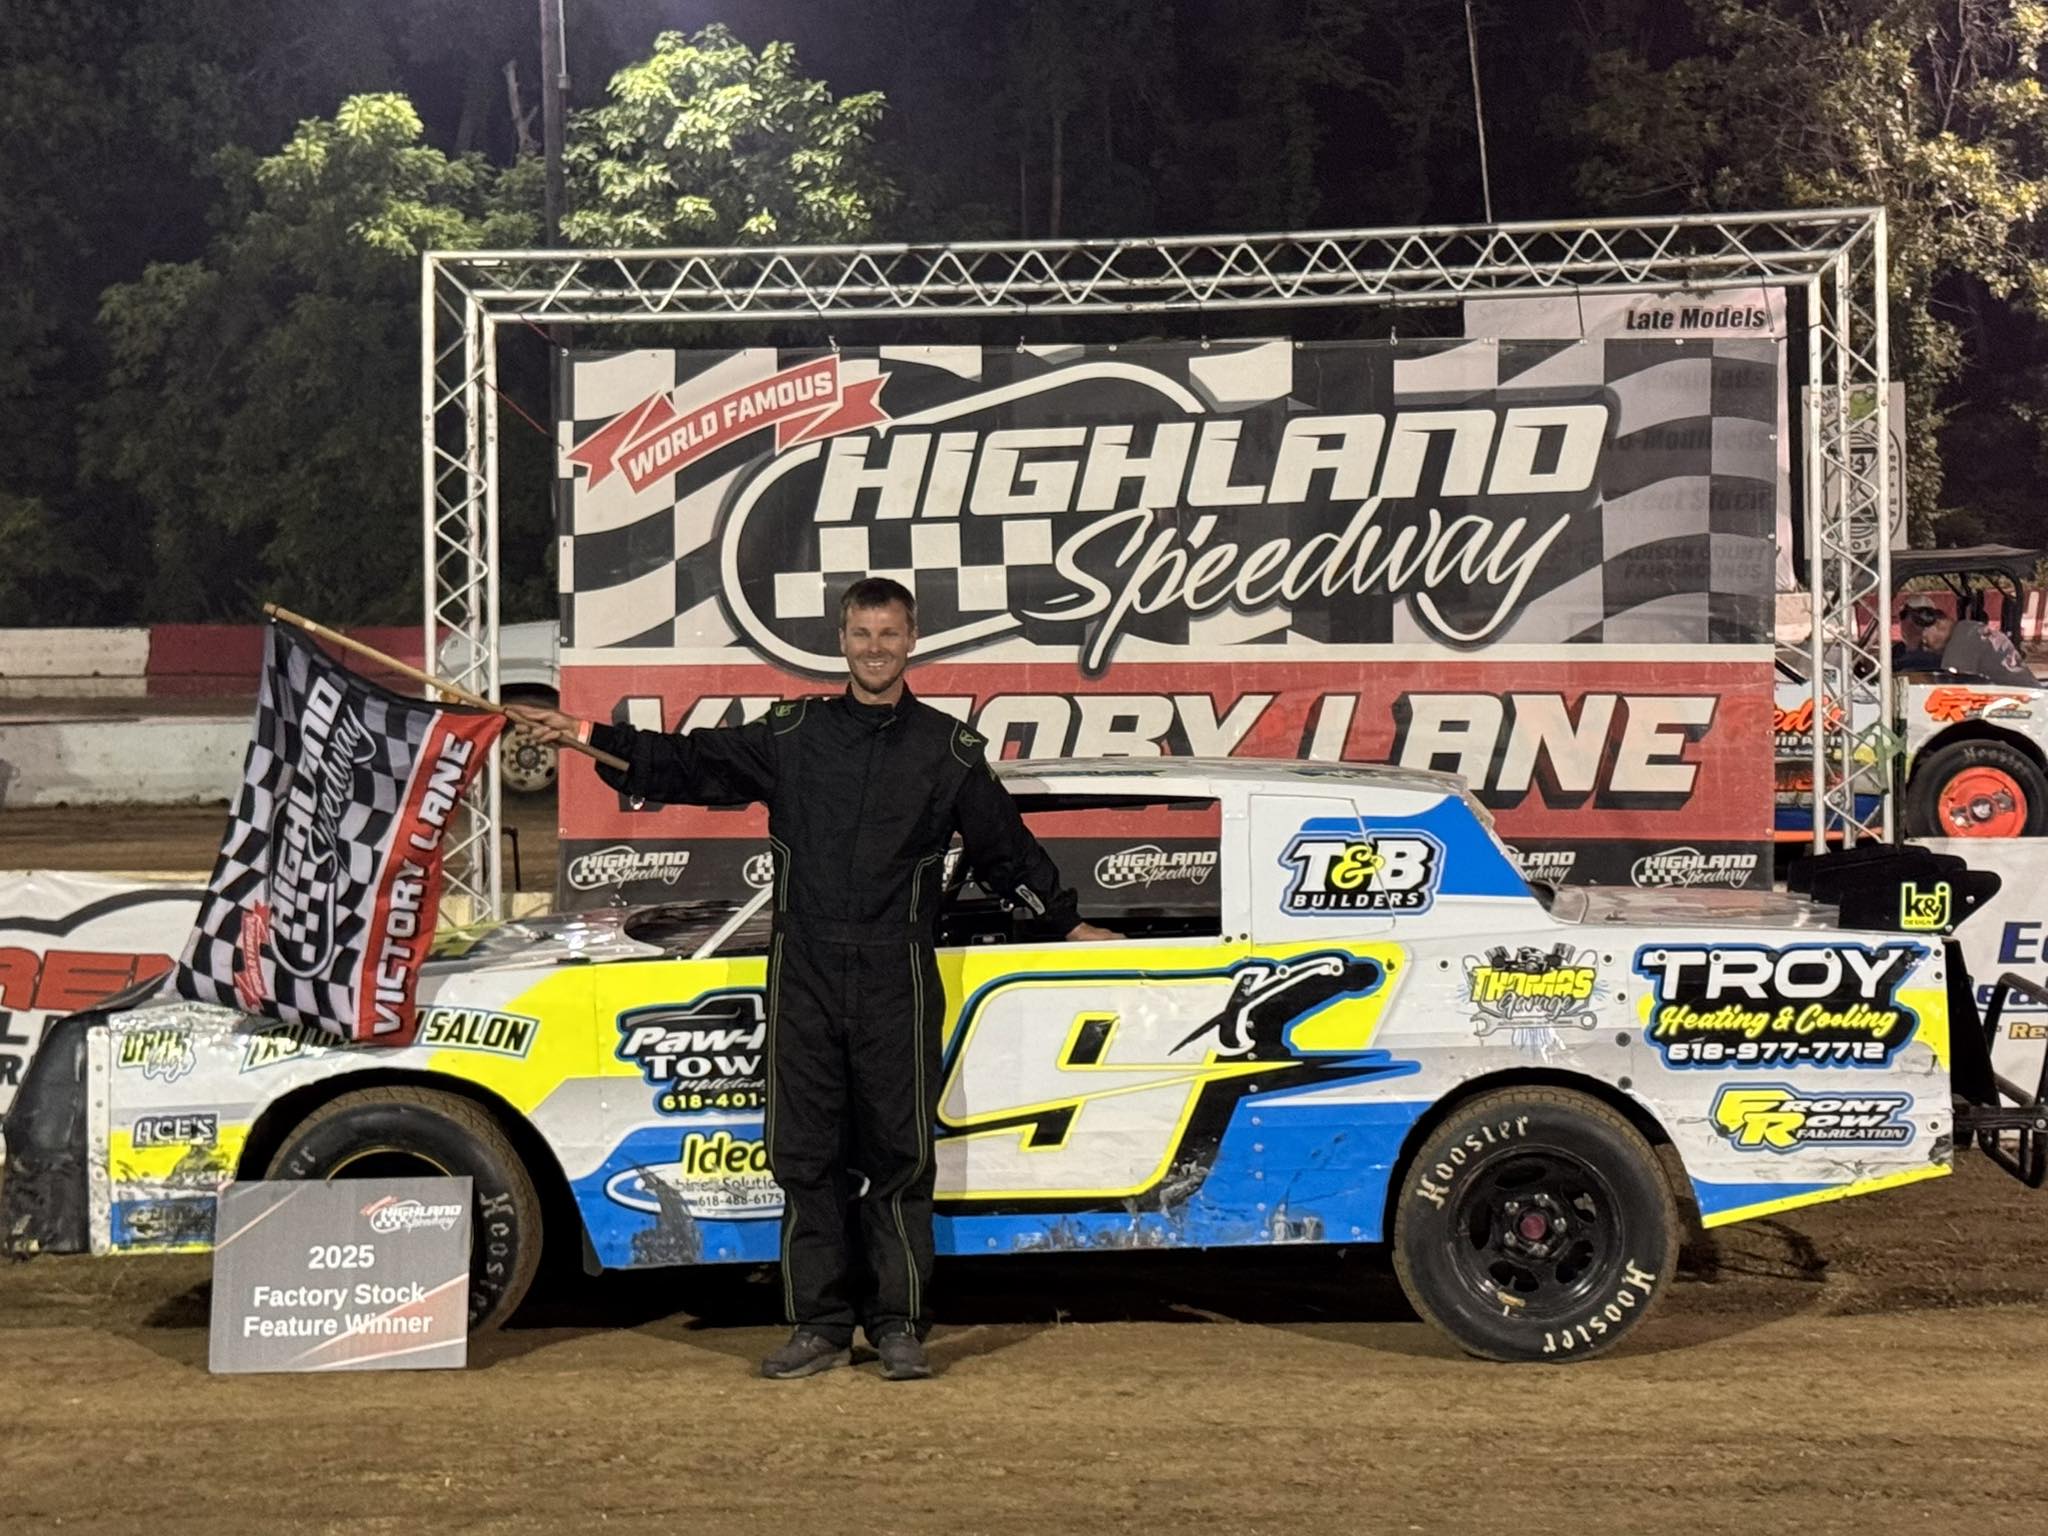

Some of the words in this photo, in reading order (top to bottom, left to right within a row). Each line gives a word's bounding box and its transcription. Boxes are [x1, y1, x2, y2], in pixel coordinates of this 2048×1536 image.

[1626, 308, 1674, 330] Late
[1679, 307, 1766, 329] Models
[628, 415, 719, 482] WORLD
[722, 370, 834, 429] FAMOUS
[813, 404, 1609, 521] HIGHLAND
[1021, 496, 1571, 670] Speedway
[270, 677, 343, 937] HIGHLAND
[581, 850, 690, 869] HIGHLAND
[1107, 851, 1217, 868] HIGHLAND
[1292, 840, 1430, 892] T&B
[1515, 851, 1576, 866] LAND
[1645, 854, 1758, 869] HIGHLAND
[374, 857, 429, 1035] VICTORY
[410, 732, 475, 851] LANE
[611, 864, 685, 889] Speedway
[1137, 865, 1213, 888] Speedway
[1676, 866, 1752, 888] Speedway
[1292, 891, 1419, 908] BUILDERS
[1472, 967, 1596, 1002] THOMAS
[1642, 949, 1904, 999] TROY
[425, 1011, 531, 1050] SALON
[1655, 1003, 1769, 1037] Heating
[1772, 1007, 1793, 1031] &
[1795, 1003, 1898, 1038] Cooling
[1667, 1041, 1885, 1061] 618-977-7712
[1717, 1090, 1903, 1133] FRONT
[1738, 1112, 1887, 1147] ROW
[1416, 1115, 1529, 1210] Hoosier
[381, 1205, 462, 1217] HIGHLAND
[308, 1244, 375, 1269] 2025
[253, 1285, 348, 1310] Factory
[354, 1281, 426, 1304] Stock
[1543, 1258, 1657, 1353] Hoosier
[243, 1314, 338, 1338] Feature
[345, 1313, 434, 1334] Winner
